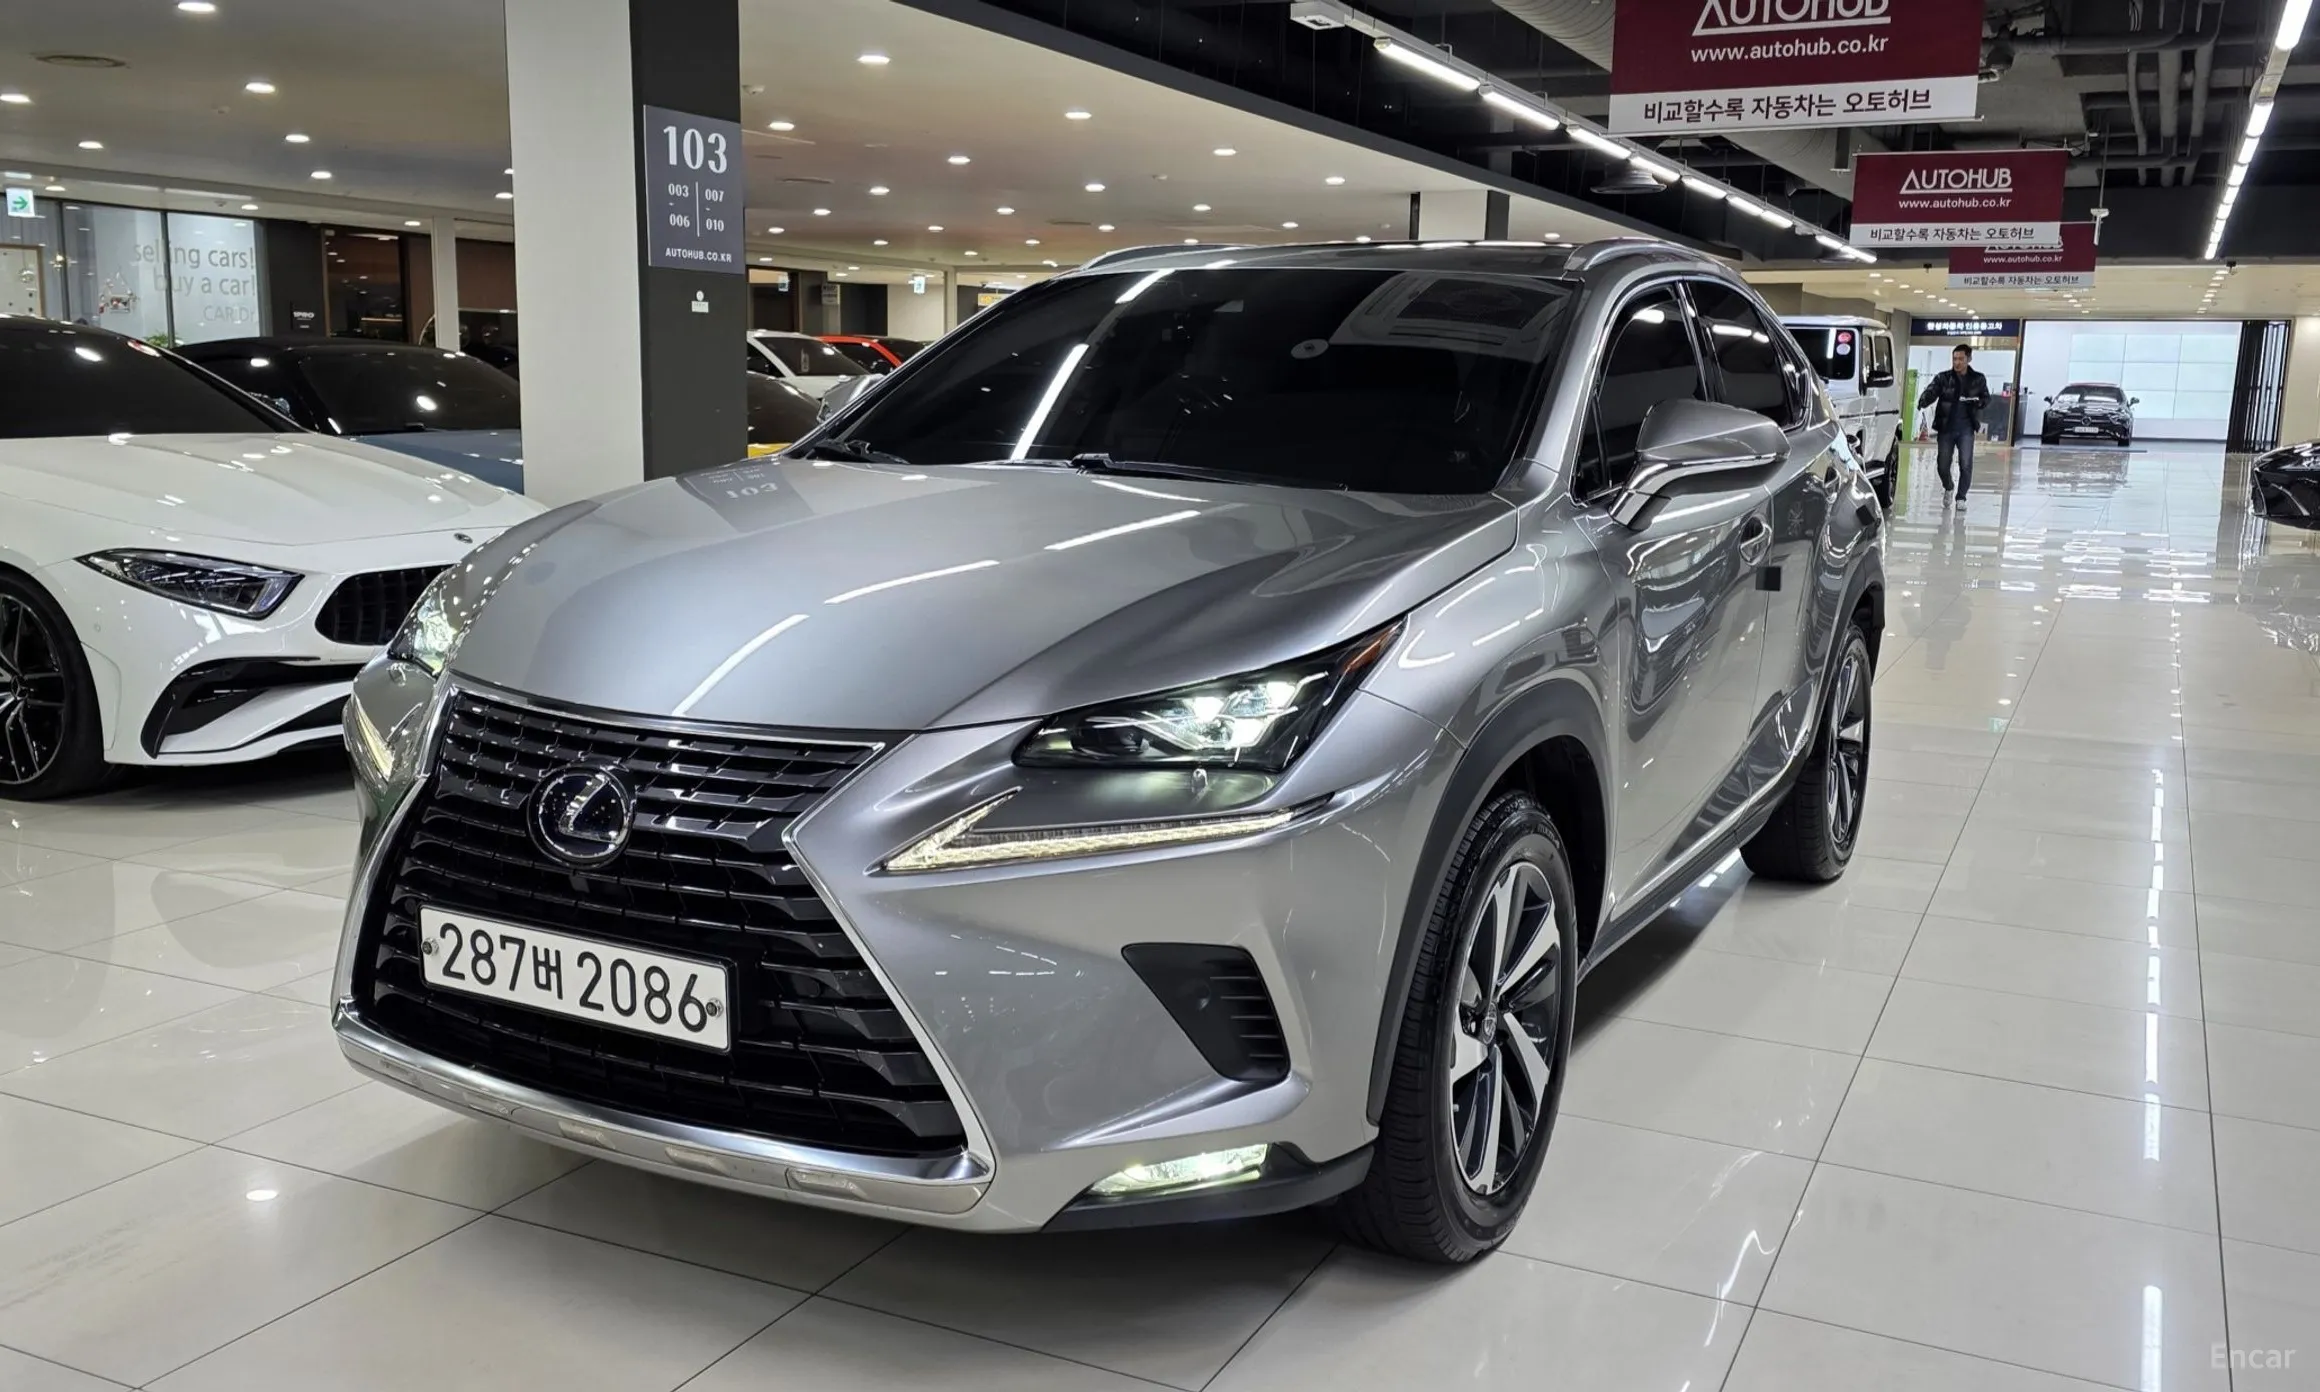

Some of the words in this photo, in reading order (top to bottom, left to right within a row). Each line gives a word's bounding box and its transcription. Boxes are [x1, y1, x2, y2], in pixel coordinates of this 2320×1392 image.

[1692, 0, 1892, 37] AUTOHUB
[1691, 34, 1889, 63] www.autohub.co.kr
[1643, 98, 1745, 124] 비교할수록
[1751, 94, 1836, 119] 자동차는
[1842, 89, 1931, 114] 오토허브
[663, 125, 728, 175] 103
[668, 183, 690, 198] 003
[1900, 168, 2013, 194] AUTOHUB
[705, 188, 725, 203] 007
[1899, 197, 2012, 209] www.autohub.co.kr
[669, 213, 690, 229] 006
[705, 218, 725, 233] 010
[1870, 228, 1929, 241] 비교할수록
[1933, 227, 1981, 241] 자동차는
[1985, 226, 2035, 240] 오토허브
[208, 247, 255, 270] cars!
[665, 247, 732, 264] AUTOHUB.CO.KR
[1983, 254, 2063, 264] www.autohub.co.kr
[153, 267, 195, 297] buy
[201, 276, 212, 294] a
[219, 274, 256, 297] car!
[439, 922, 564, 1001] 287버
[576, 950, 708, 1033] 2086
